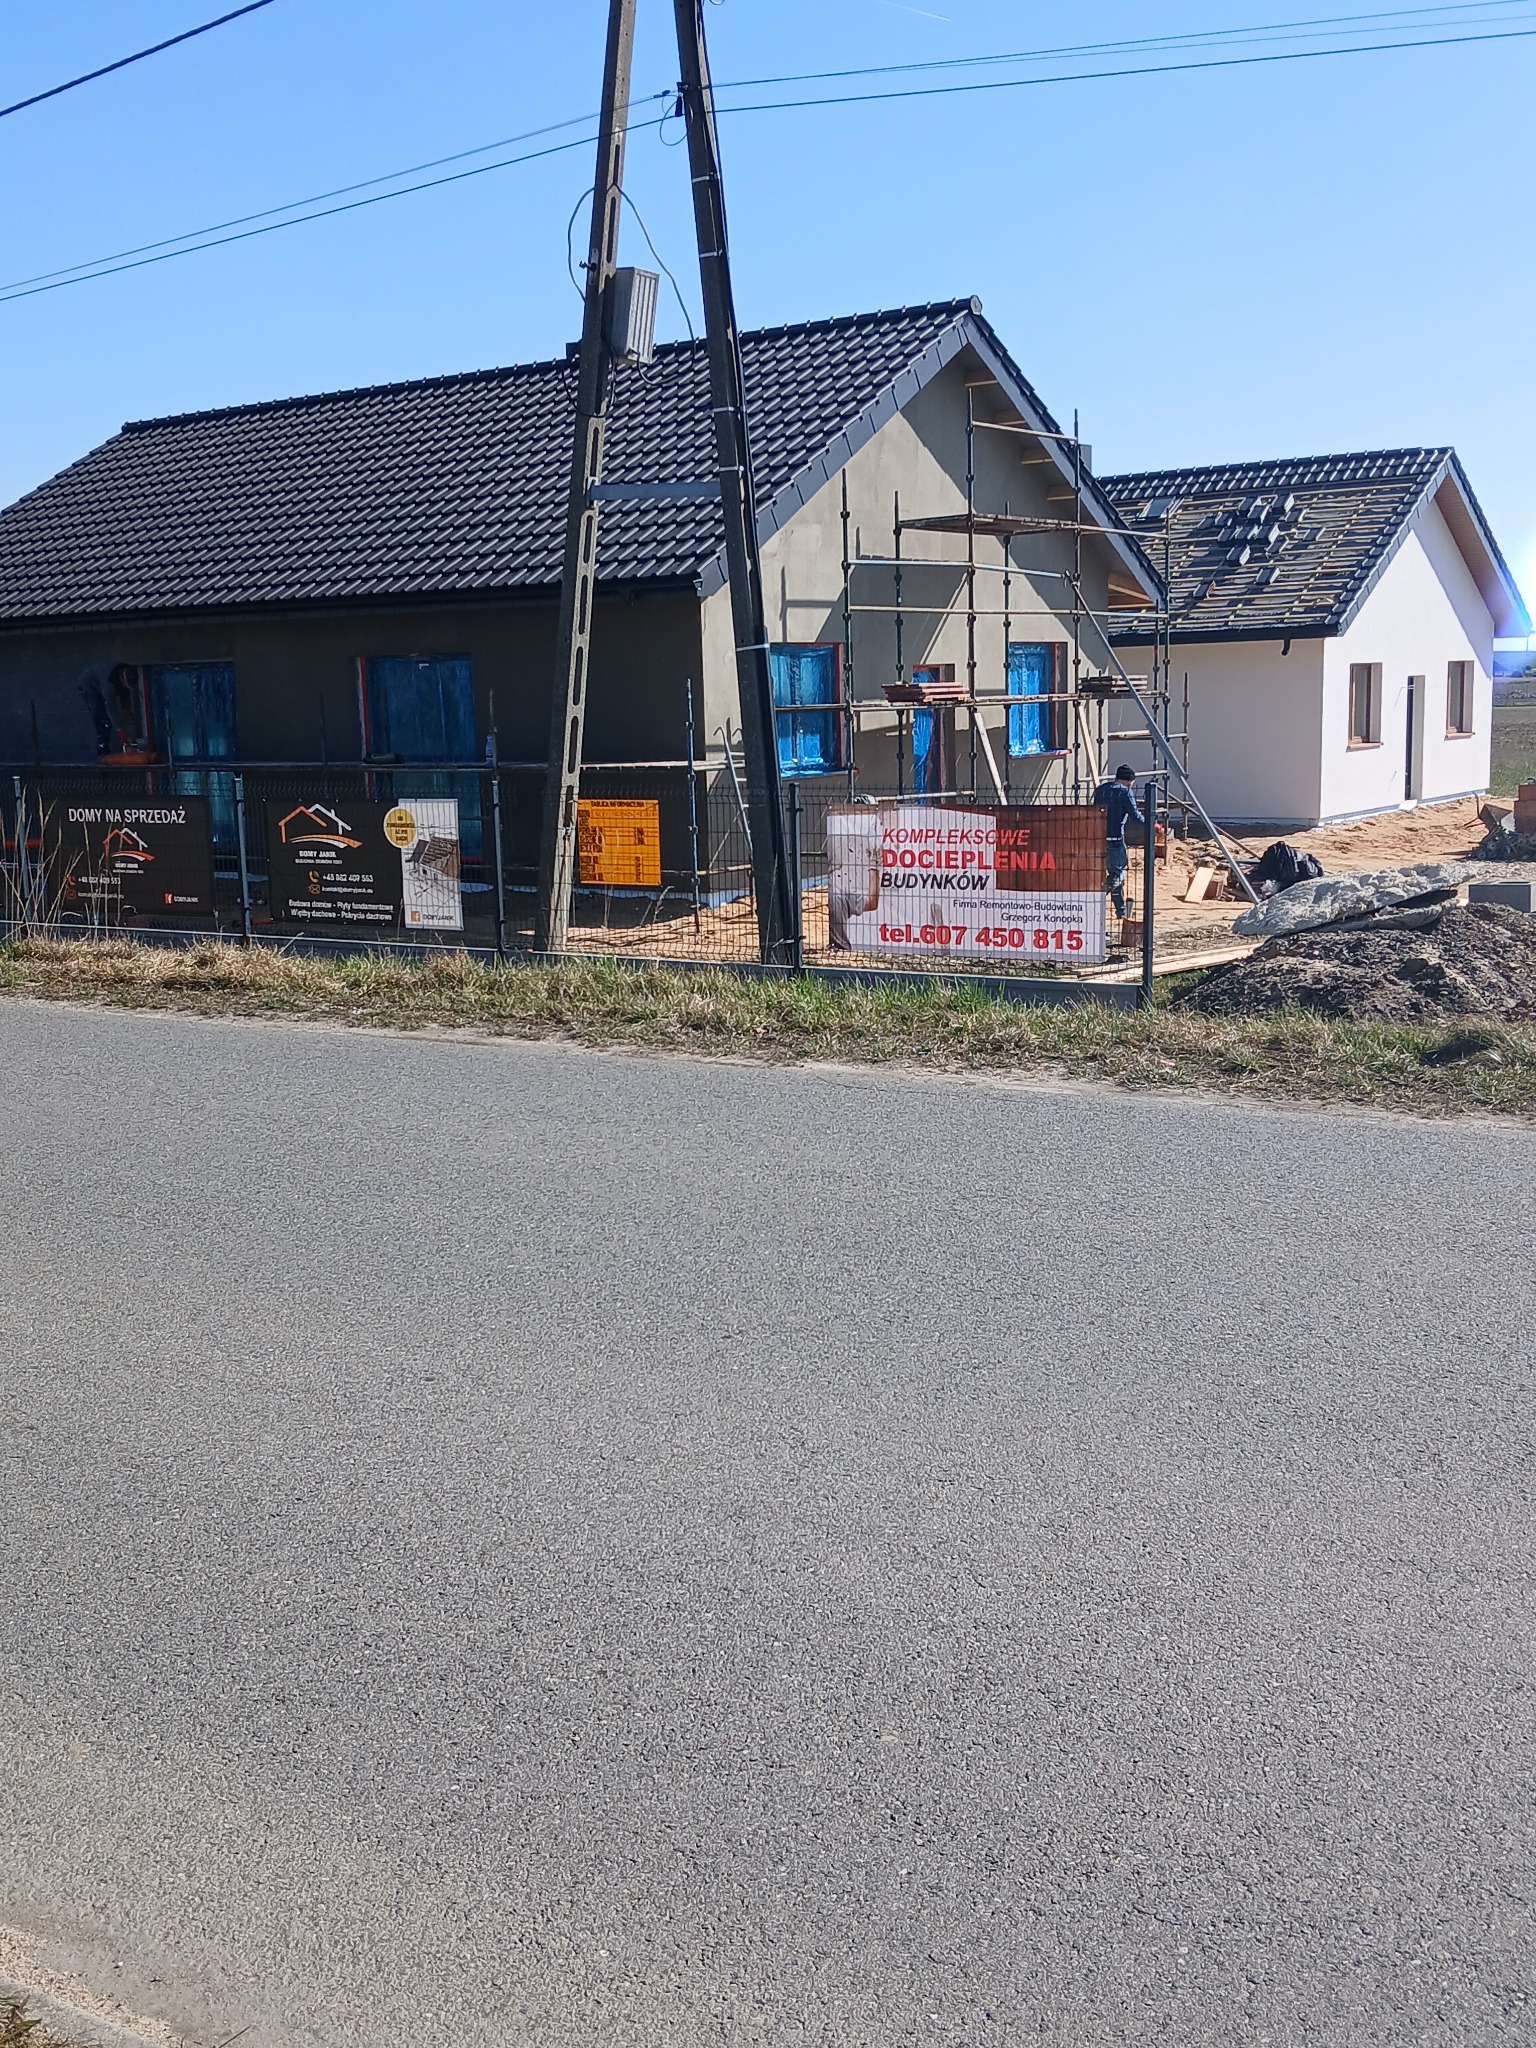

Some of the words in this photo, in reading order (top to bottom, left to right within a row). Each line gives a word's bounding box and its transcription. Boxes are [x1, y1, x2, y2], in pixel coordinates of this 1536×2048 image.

[68, 808, 102, 823] DOMY
[105, 808, 122, 823] NA
[124, 805, 186, 824] SPRZEDAŻ
[882, 828, 1030, 846] KOMPLEKSOWE
[882, 849, 1056, 871] DOCIEPLENIA
[880, 872, 990, 891] BUDYNKÓW
[953, 900, 977, 909] Firma
[979, 900, 1083, 912] Remontowo-Budowlana
[1001, 913, 1042, 924] Grzegorz
[1043, 914, 1083, 924] Konopka
[879, 923, 967, 945] tel.607
[974, 926, 1025, 948] 450
[1033, 929, 1083, 951] 815
